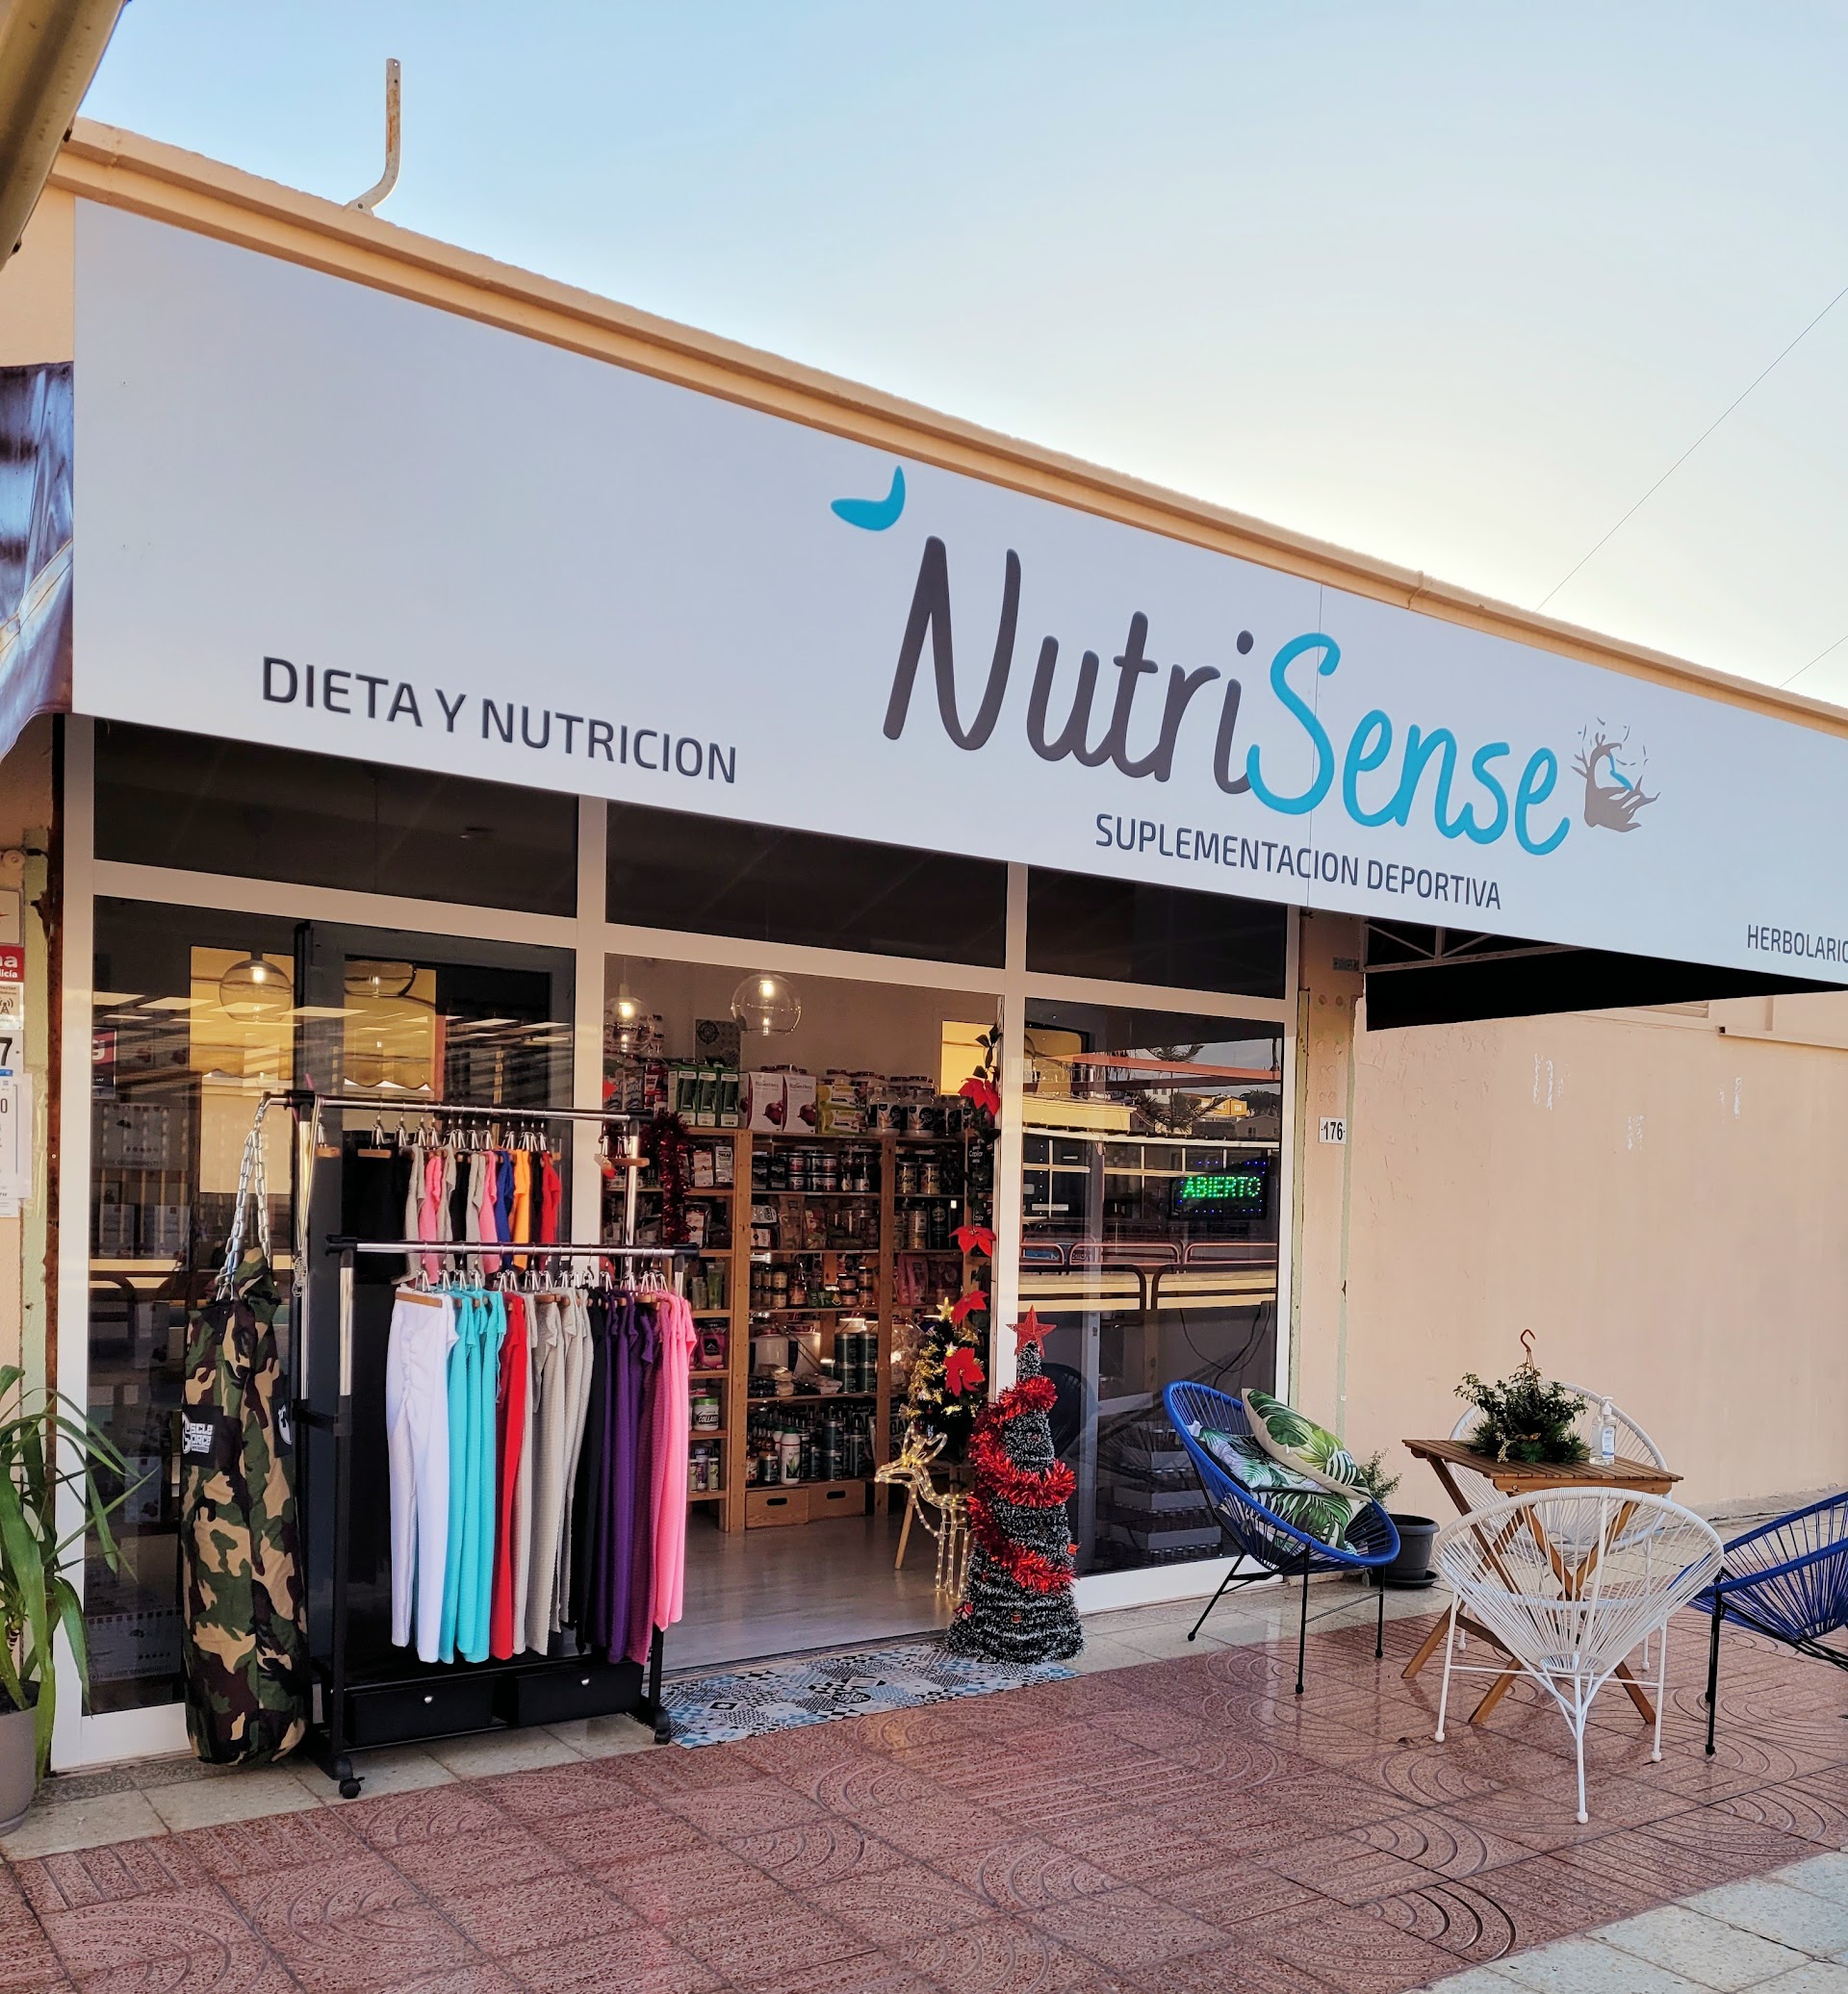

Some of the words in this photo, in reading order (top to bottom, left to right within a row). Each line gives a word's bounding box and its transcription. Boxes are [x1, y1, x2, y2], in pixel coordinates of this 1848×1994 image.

[262, 655, 424, 728] DIETA
[434, 687, 467, 733] Y
[481, 698, 736, 783] NUTRICION
[883, 535, 1570, 856] NutriSense
[1095, 813, 1359, 886] SUPLEMENTACION
[1366, 859, 1502, 910] DEPORTIVA
[1323, 1121, 1344, 1141] 176
[1182, 1176, 1262, 1198] ABIERTO
